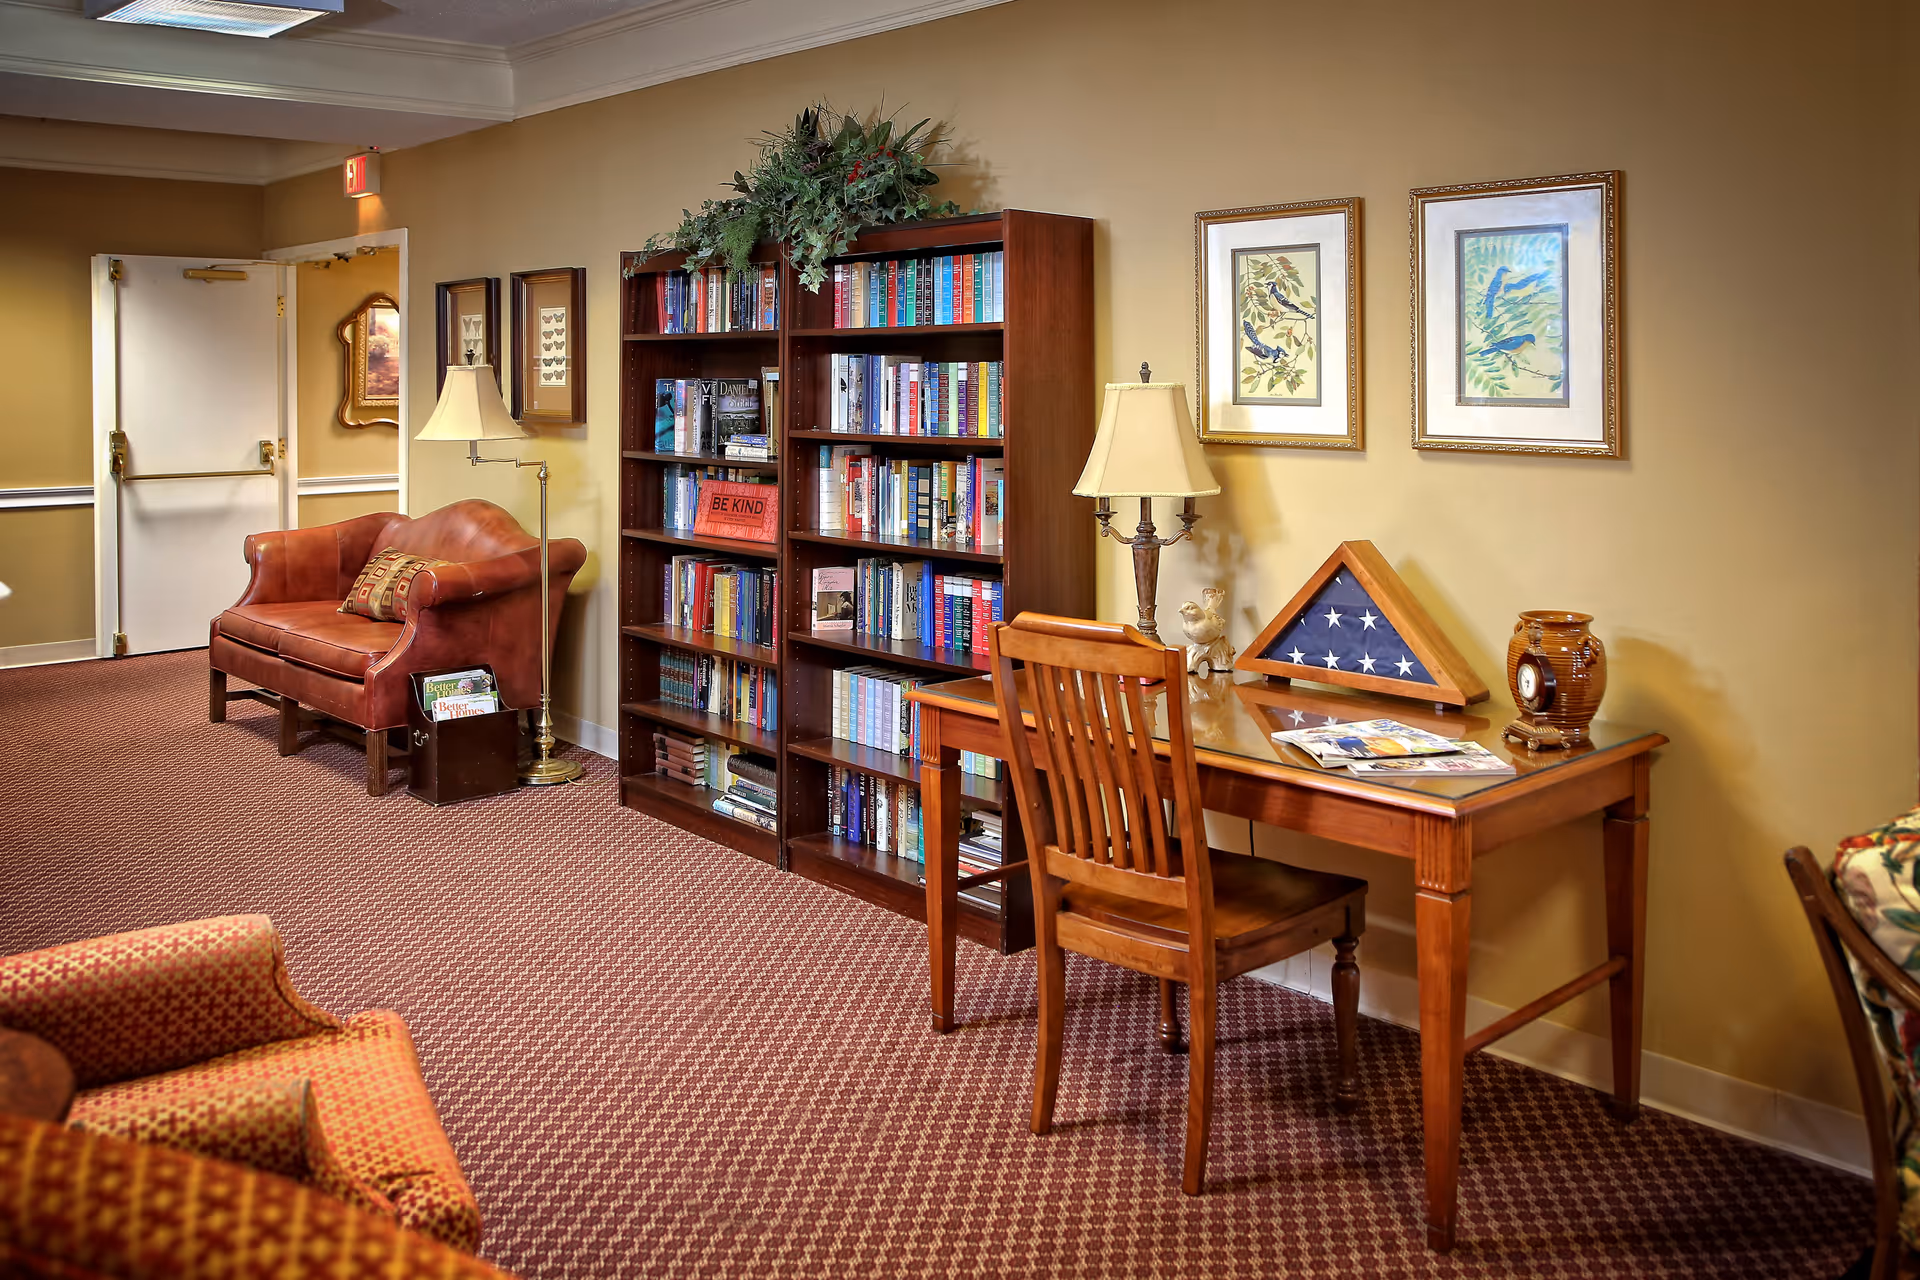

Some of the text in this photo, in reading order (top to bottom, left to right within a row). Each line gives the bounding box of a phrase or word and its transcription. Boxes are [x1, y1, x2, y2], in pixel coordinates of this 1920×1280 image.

[347, 156, 366, 193] EXIT
[712, 497, 764, 514] BE KIND
[427, 682, 456, 693] Better
[437, 686, 472, 698] Homes
[439, 701, 469, 712] Better
[449, 707, 485, 719] Homes
